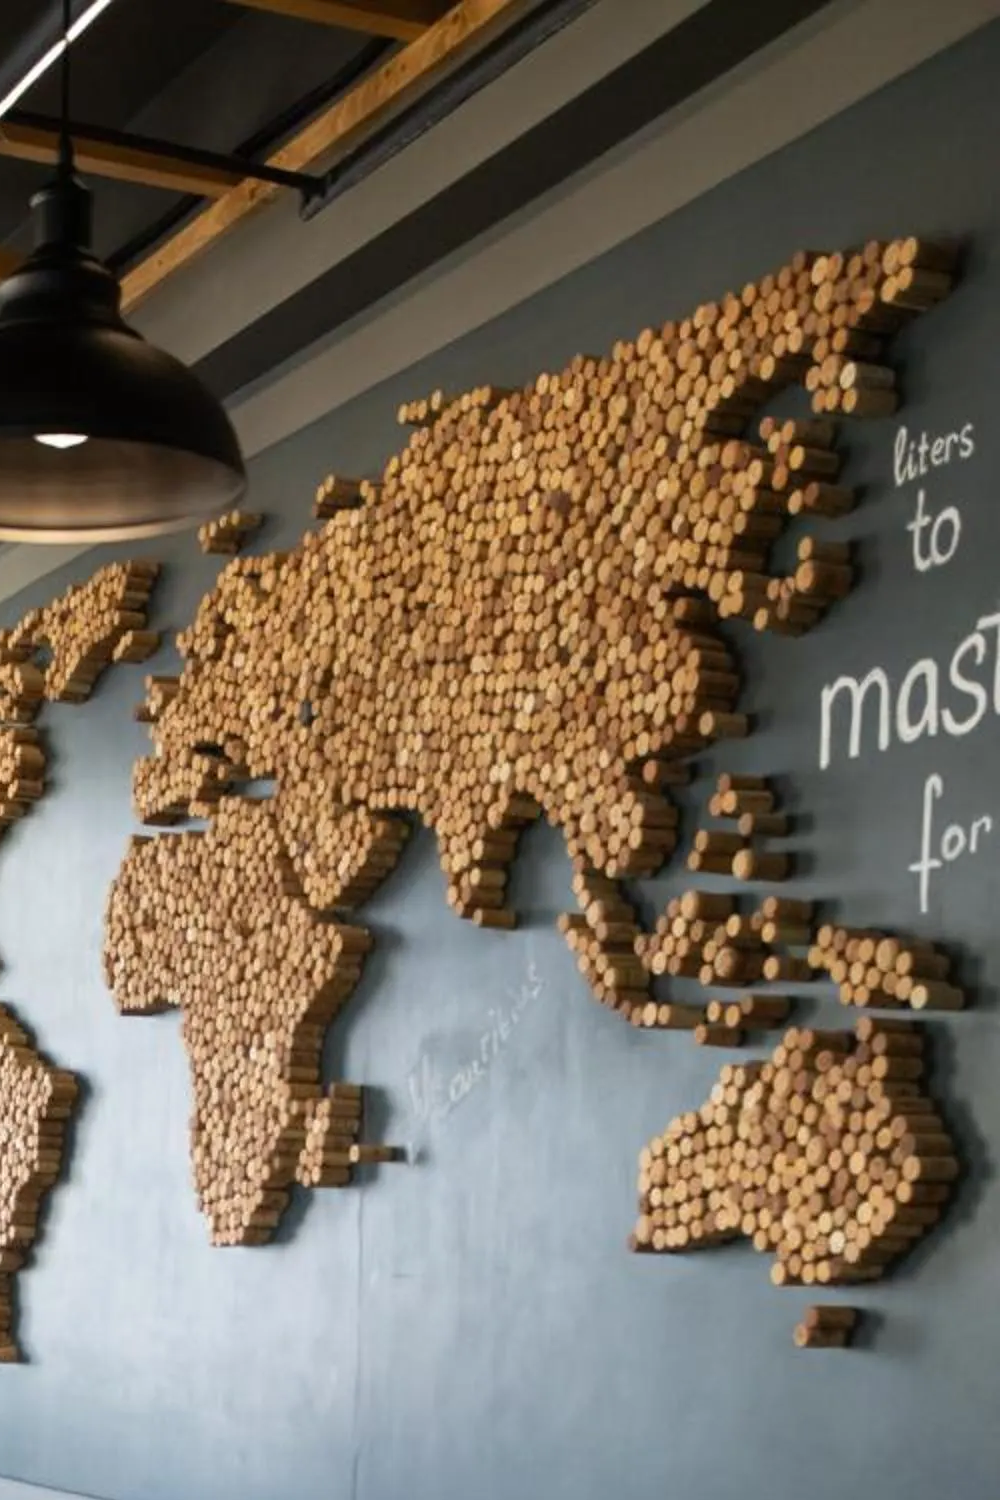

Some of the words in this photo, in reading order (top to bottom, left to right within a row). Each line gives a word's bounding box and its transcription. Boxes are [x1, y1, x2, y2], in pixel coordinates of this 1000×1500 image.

[894, 422, 974, 487] liters
[905, 489, 962, 572] to
[908, 773, 993, 914] for
